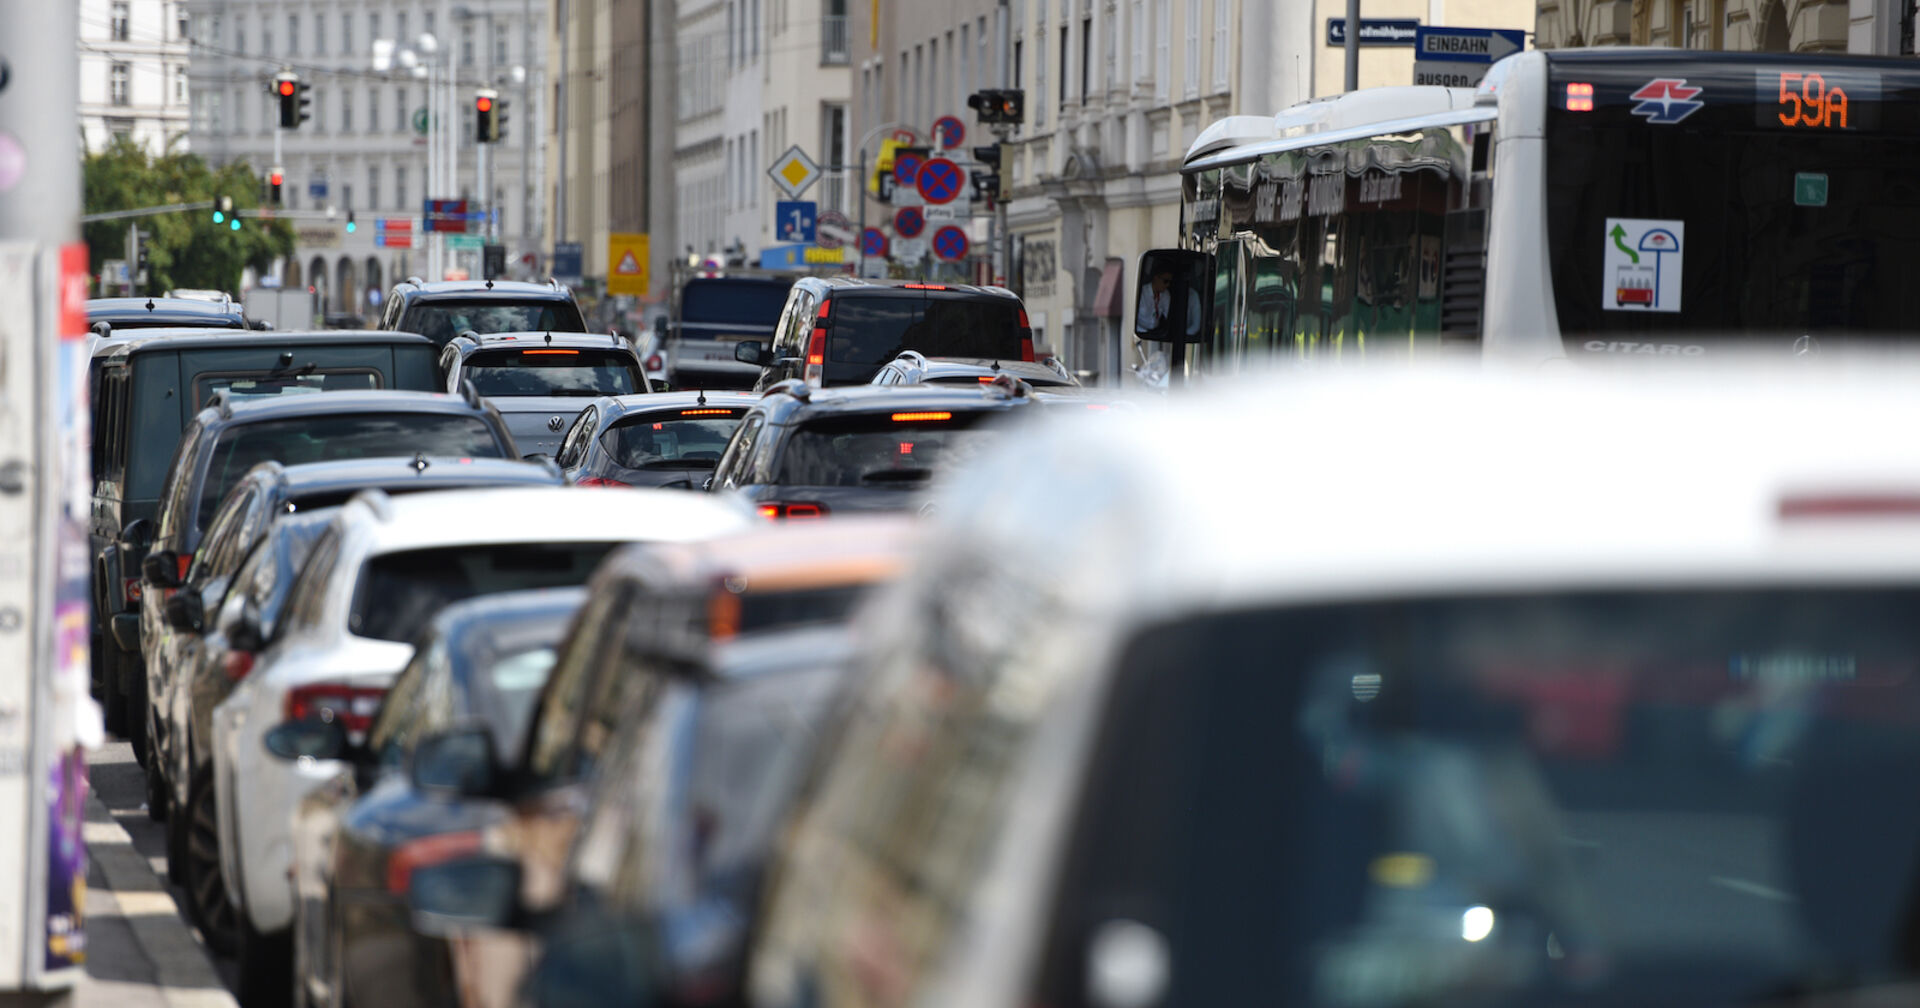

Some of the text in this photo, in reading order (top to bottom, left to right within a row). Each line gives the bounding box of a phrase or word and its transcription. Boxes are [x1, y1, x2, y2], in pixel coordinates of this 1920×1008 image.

[1427, 36, 1489, 53] EINBAHN
[1779, 72, 1848, 128] 59A
[1584, 340, 1705, 356] CITARO
